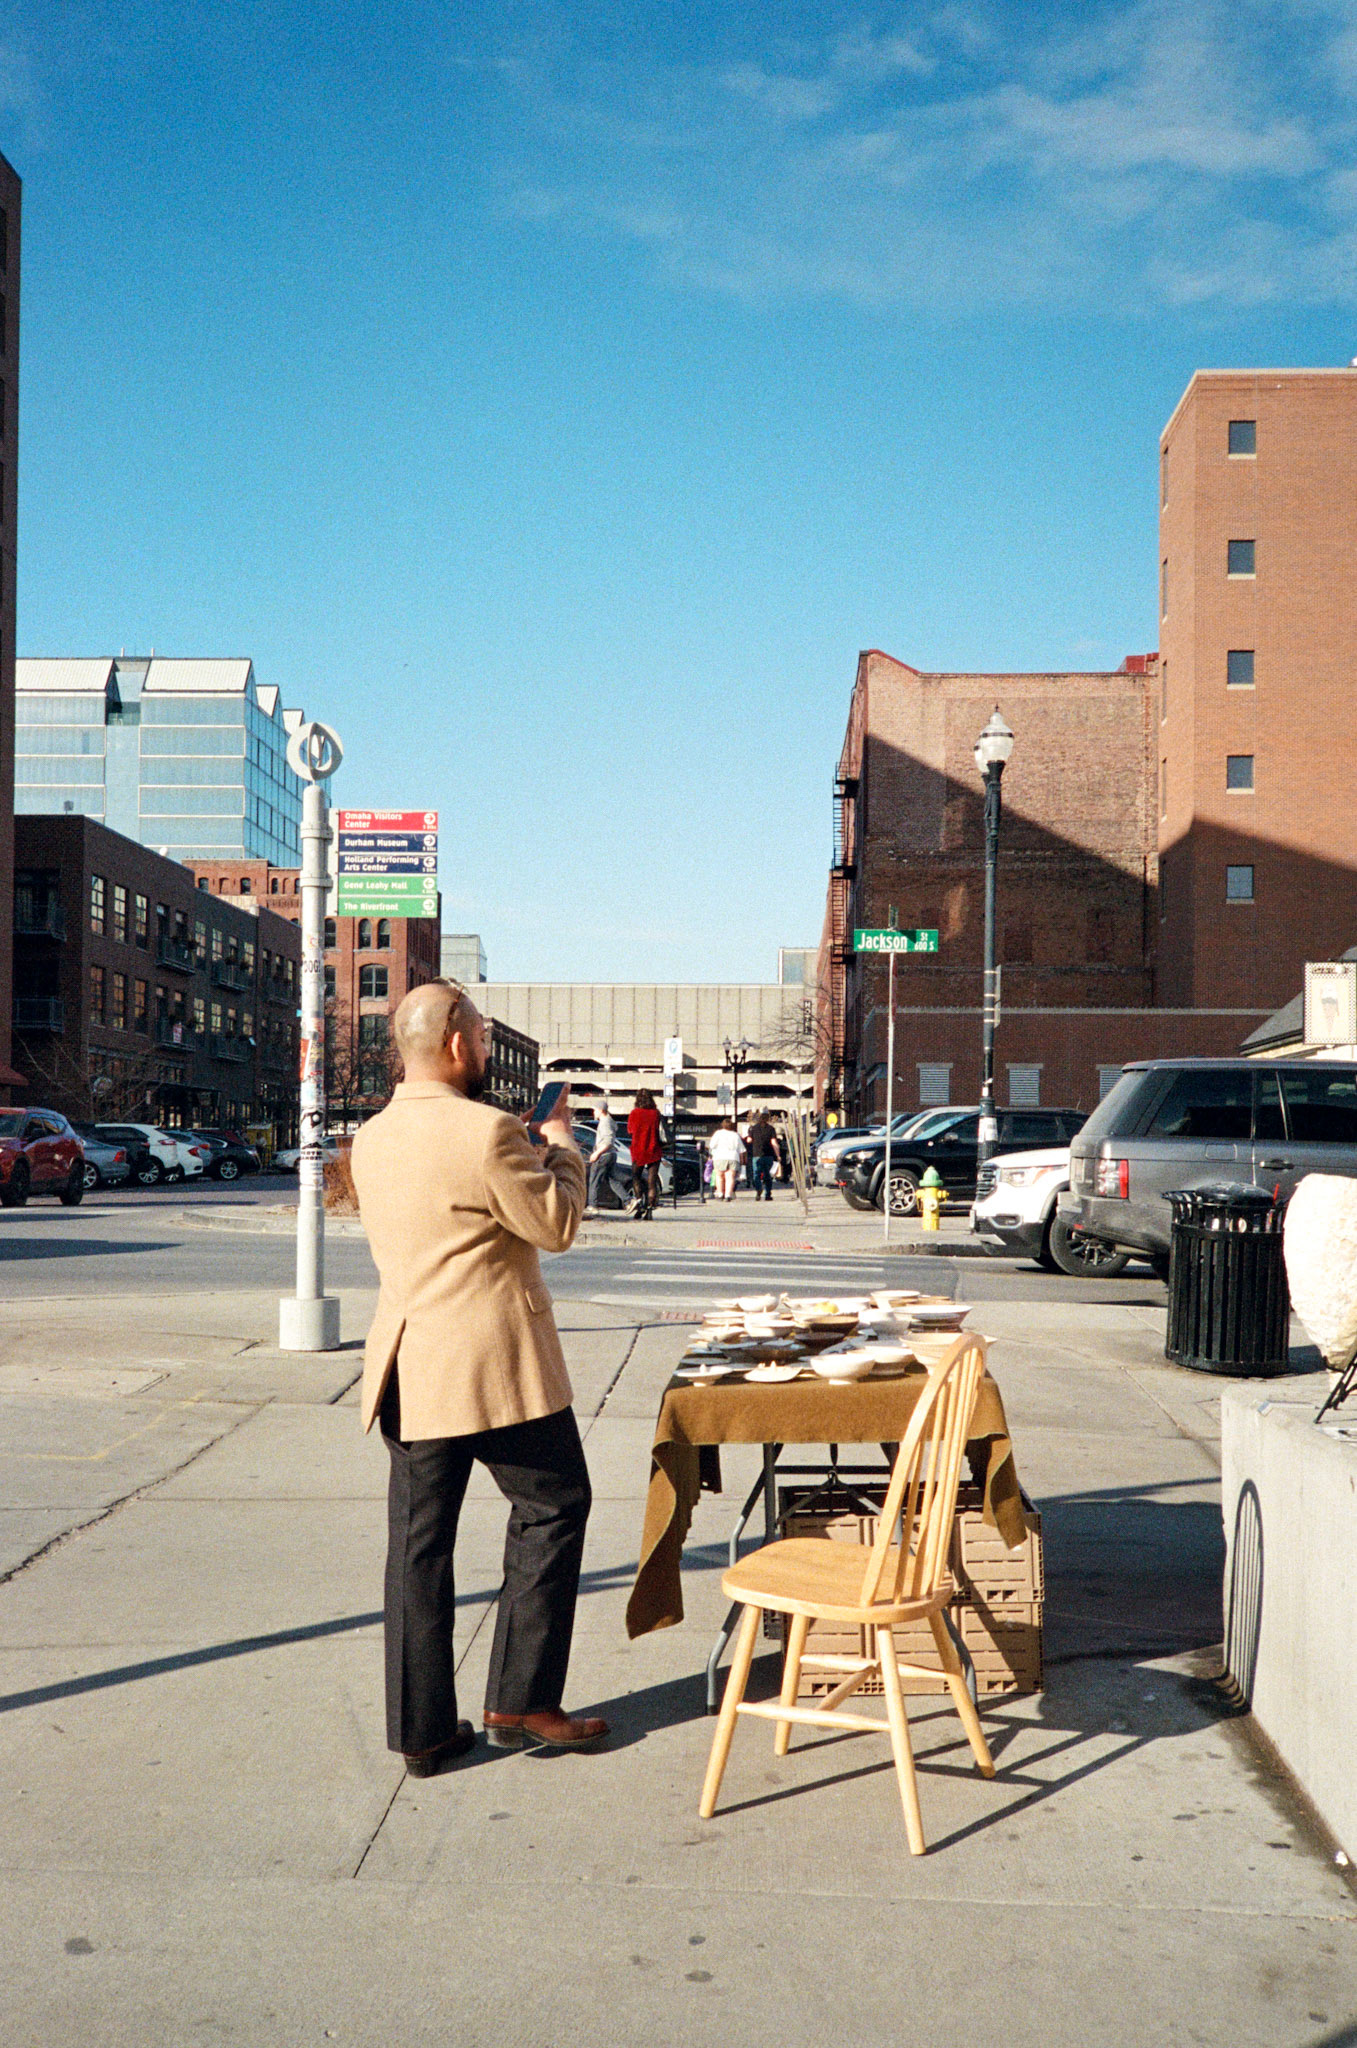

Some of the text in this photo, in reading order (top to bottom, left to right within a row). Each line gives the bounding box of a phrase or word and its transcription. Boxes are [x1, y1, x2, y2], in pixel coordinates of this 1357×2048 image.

[344, 839, 408, 847] Durham Museum
[377, 856, 419, 865] Performing
[366, 882, 389, 890] Leahy
[857, 932, 928, 949] Jackson St
[914, 941, 935, 951] 600 S
